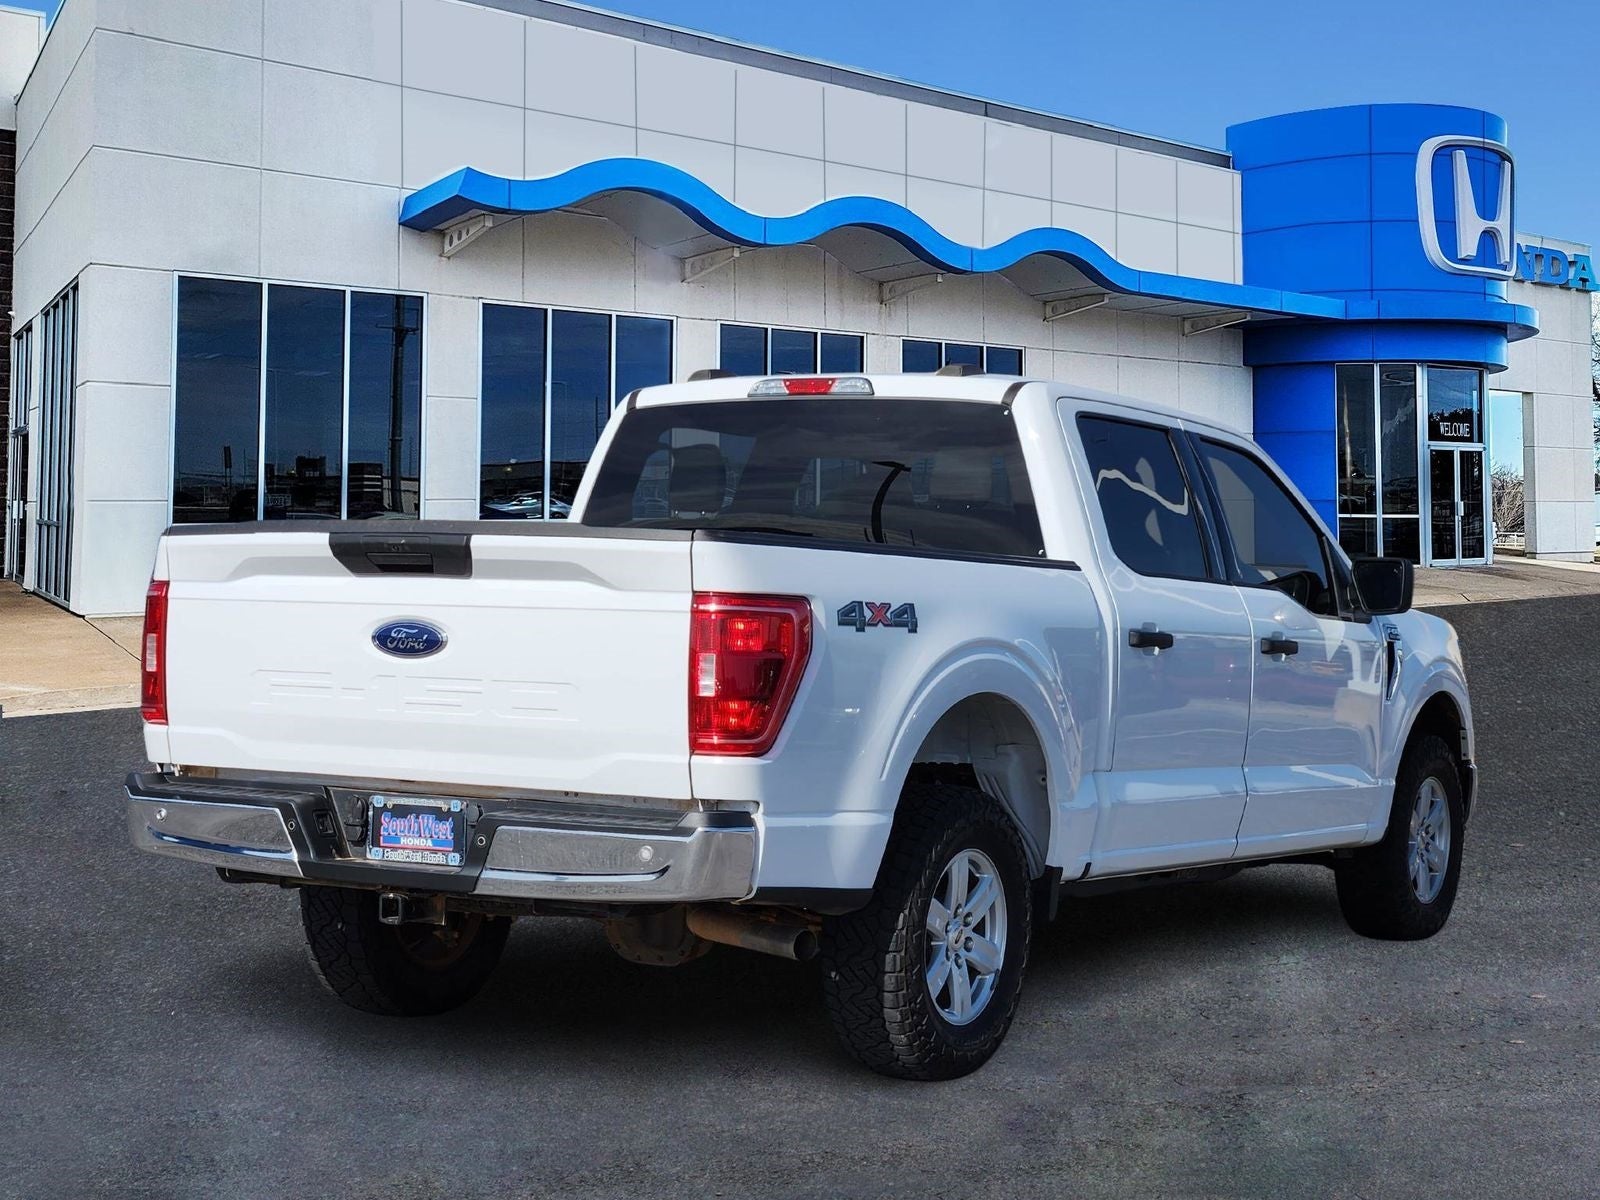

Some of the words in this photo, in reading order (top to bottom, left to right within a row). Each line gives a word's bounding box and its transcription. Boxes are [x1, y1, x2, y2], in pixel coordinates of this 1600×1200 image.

[1514, 243, 1600, 292] NDA
[1439, 421, 1471, 438] WELCOME
[386, 627, 428, 650] Ford
[400, 837, 433, 847] HONDA
